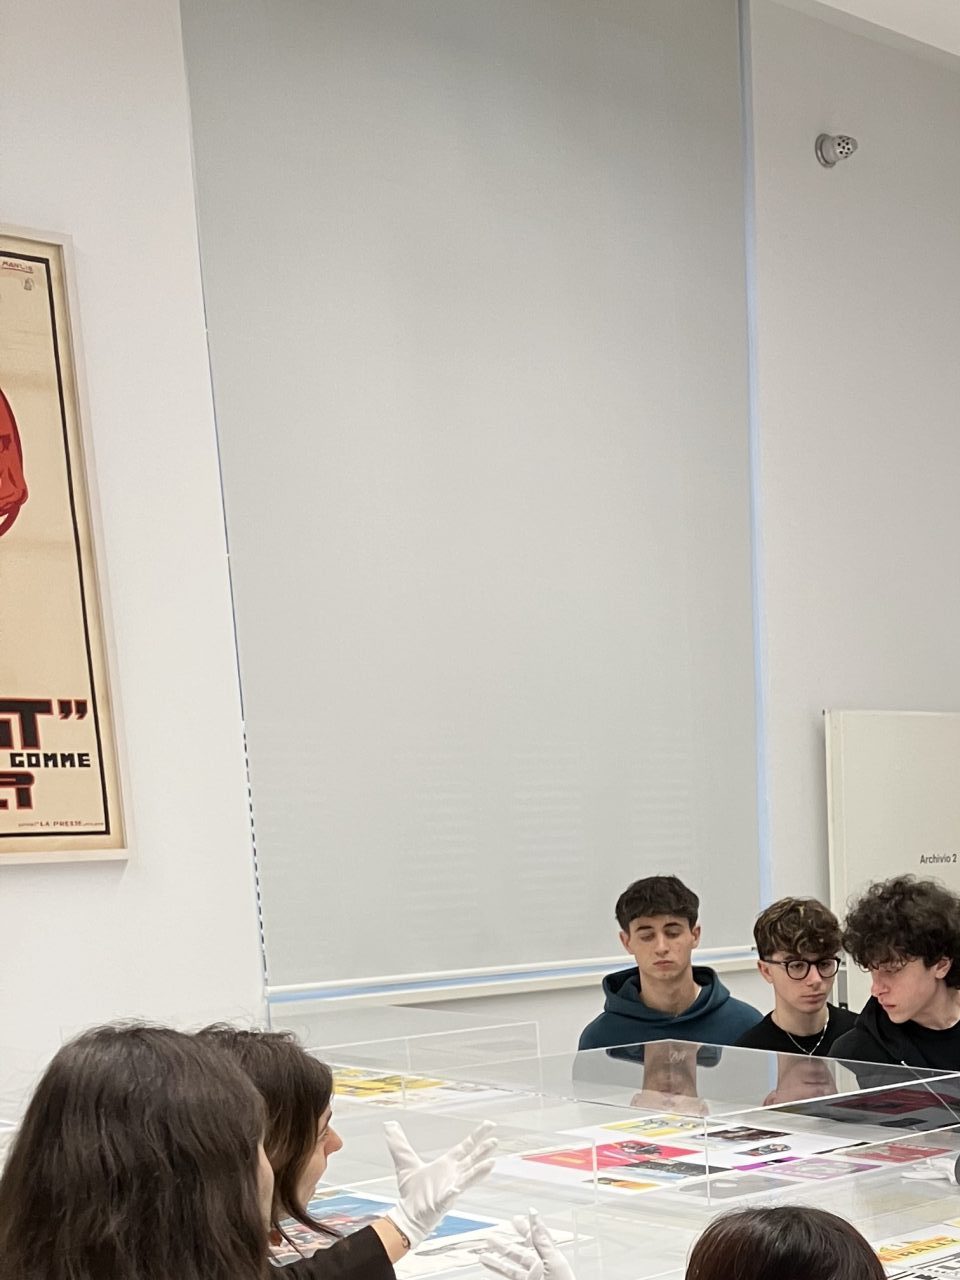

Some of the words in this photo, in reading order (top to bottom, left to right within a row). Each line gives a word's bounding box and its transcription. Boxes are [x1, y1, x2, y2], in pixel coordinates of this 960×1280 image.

[9, 752, 91, 768] GOMME
[920, 854, 951, 864] Archivio
[952, 853, 957, 863] 2
